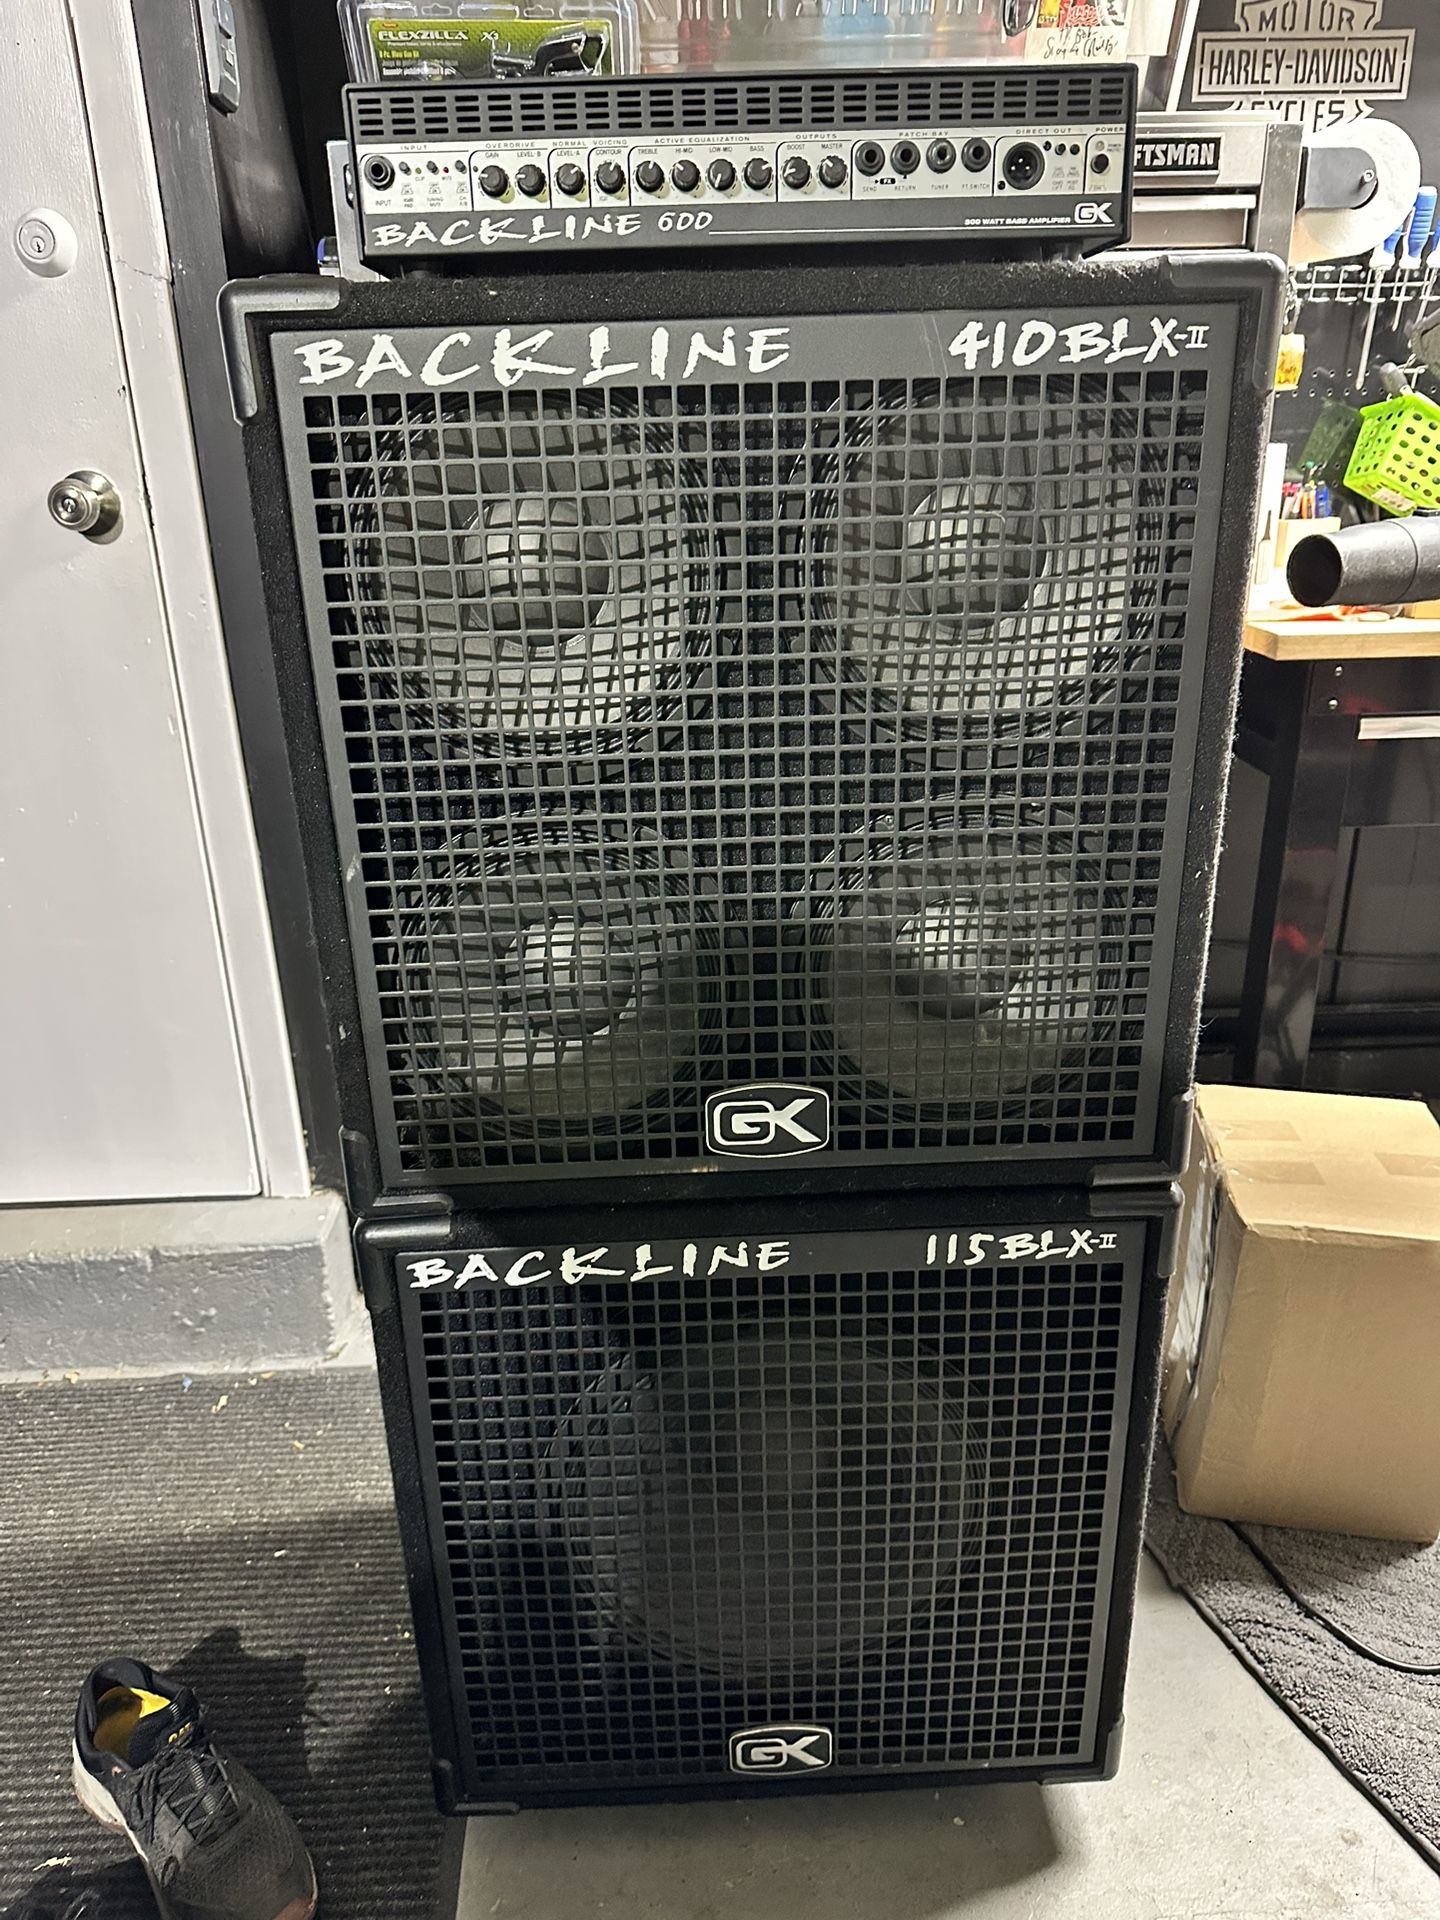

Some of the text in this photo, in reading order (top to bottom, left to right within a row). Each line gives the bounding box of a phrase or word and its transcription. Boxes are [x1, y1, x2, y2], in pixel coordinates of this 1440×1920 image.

[1258, 0, 1356, 32] MOTOR
[378, 30, 469, 41] FLEXZILLA
[1208, 48, 1398, 86] HARLEY-DAVIDSON
[1134, 143, 1215, 166] FTSMAN
[372, 211, 713, 247] BACKLINE 600
[1005, 217, 1028, 225] BASS
[1028, 216, 1071, 224] AMPLIFIER
[1074, 202, 1113, 224] GK
[294, 325, 790, 388] BACKLINE
[948, 317, 1210, 370] 410BLX-II
[713, 1098, 822, 1146] GK
[406, 1241, 790, 1289] BACKLINE
[736, 1735, 825, 1769] GK
